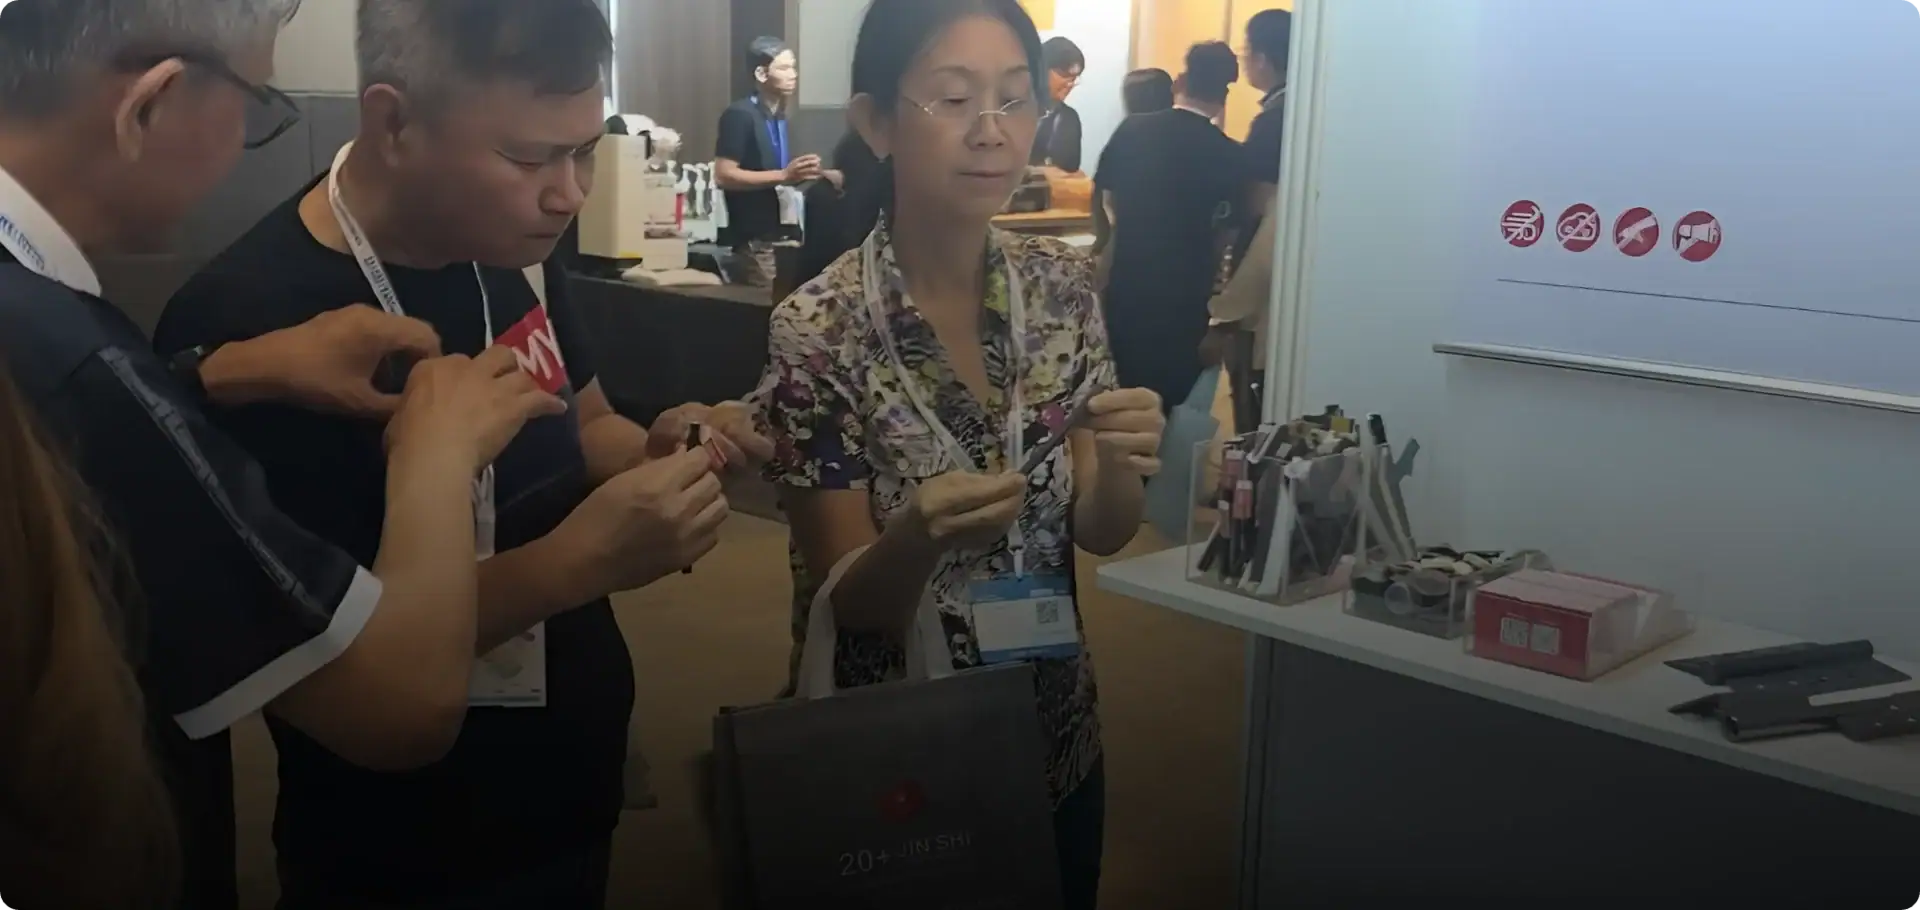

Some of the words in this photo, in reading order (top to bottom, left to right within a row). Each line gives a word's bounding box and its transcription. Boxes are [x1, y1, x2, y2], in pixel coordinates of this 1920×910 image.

[839, 849, 891, 877] 20+
[898, 838, 930, 858] JIN
[935, 830, 972, 851] SHI
